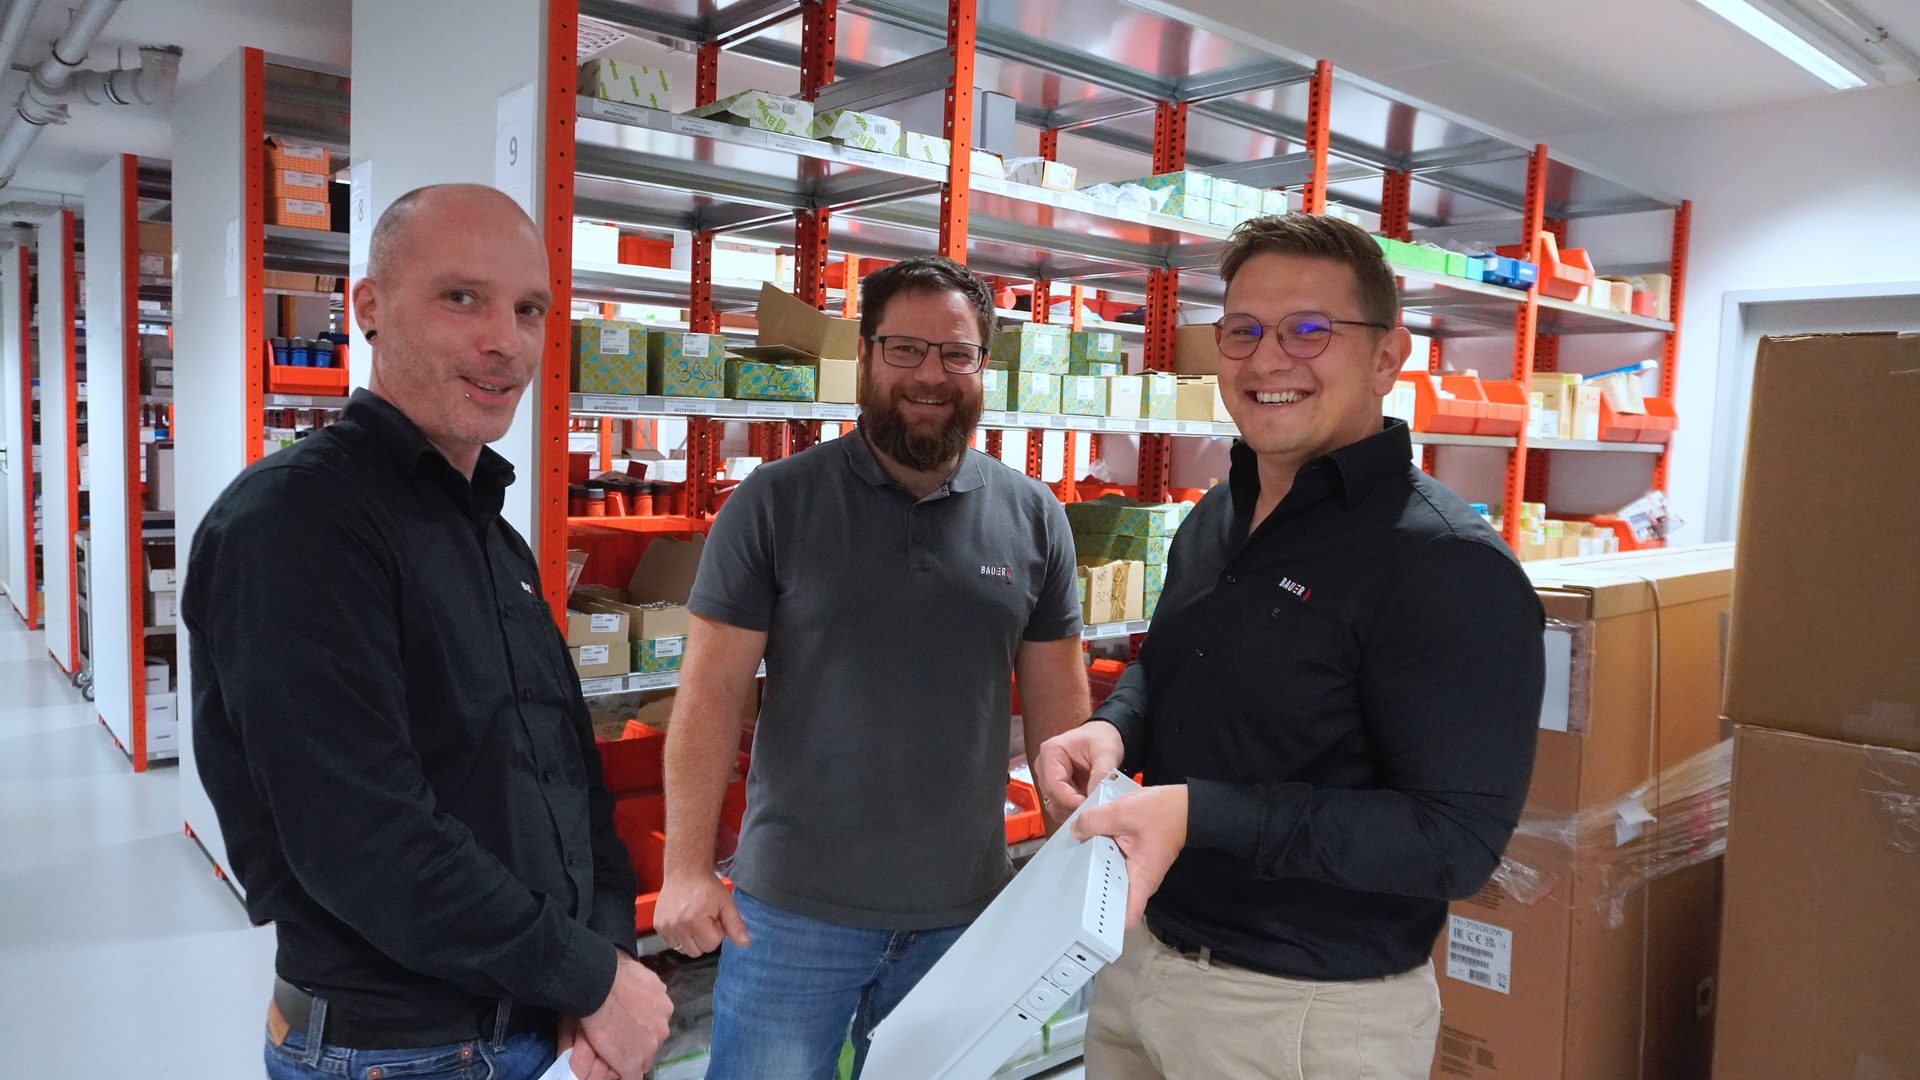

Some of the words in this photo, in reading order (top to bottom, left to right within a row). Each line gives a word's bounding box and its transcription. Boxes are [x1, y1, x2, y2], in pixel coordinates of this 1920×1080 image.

[510, 136, 518, 166] 9
[358, 199, 364, 221] 8
[980, 565, 1006, 577] BAUER
[1279, 577, 1305, 596] BAUER
